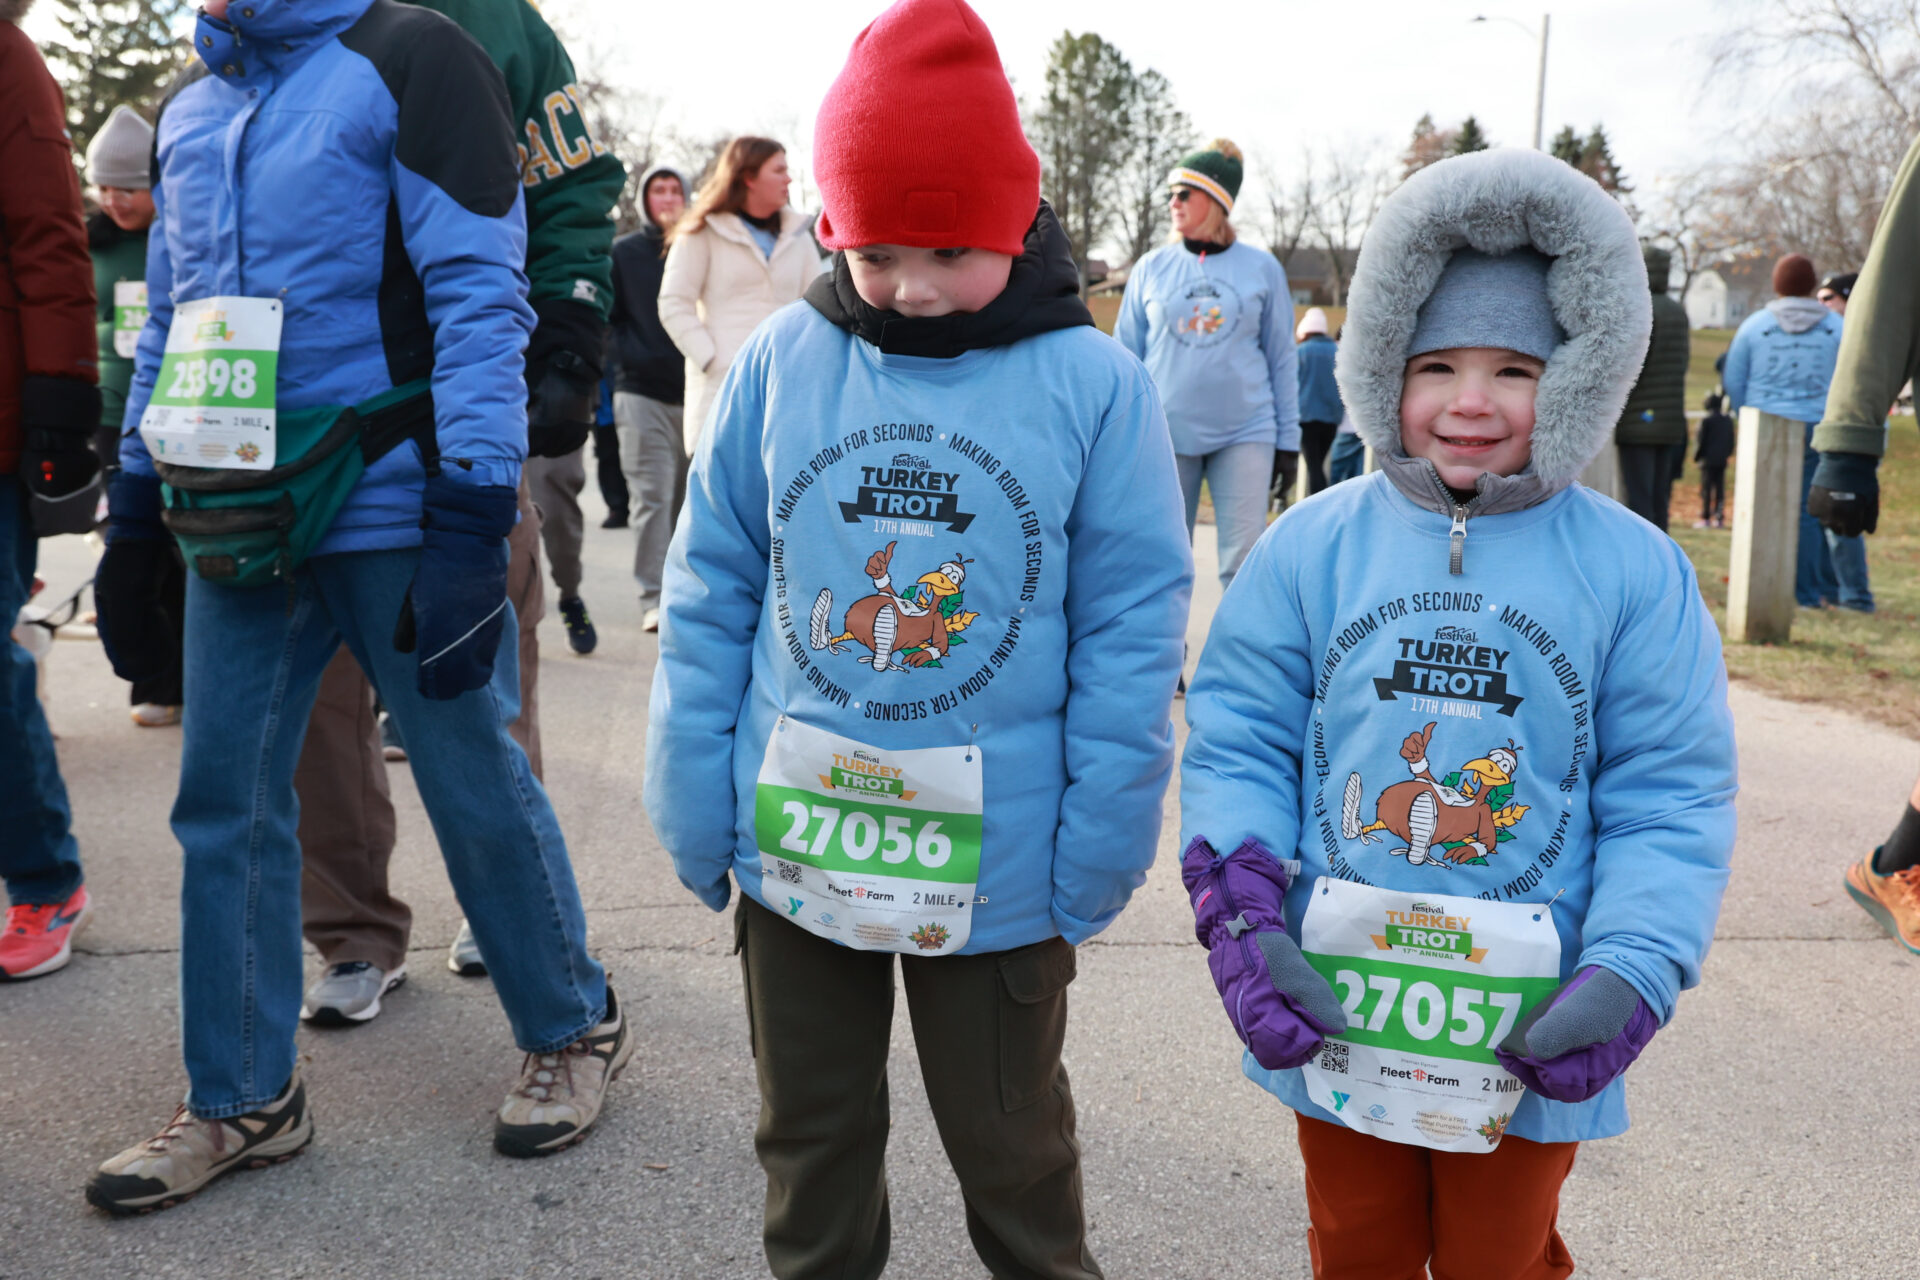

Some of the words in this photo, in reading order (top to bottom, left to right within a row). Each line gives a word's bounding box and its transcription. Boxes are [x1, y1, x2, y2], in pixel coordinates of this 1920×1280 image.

[516, 83, 607, 187] AC
[892, 454, 930, 470] festival
[949, 433, 1001, 475] MAKING
[776, 469, 814, 522] MAKING
[809, 444, 844, 476] ROOM
[843, 429, 869, 453] FOR
[873, 423, 934, 443] SECONDS
[861, 466, 960, 492] TURKEY
[871, 492, 943, 517] TROT
[995, 469, 1030, 511] ROOM
[873, 520, 897, 534] 17TH
[900, 522, 935, 537] ANNUAL
[1019, 510, 1041, 539] FOR
[1020, 541, 1042, 602] SECONDS
[778, 600, 793, 629] FOR
[989, 616, 1022, 668] MAKING
[1316, 647, 1342, 704] MAKING
[1336, 612, 1378, 653] ROOM
[1378, 597, 1408, 625] FOR
[1412, 591, 1483, 613] SECONDS
[1435, 627, 1476, 643] festival
[785, 630, 811, 671] ROOM
[1398, 638, 1510, 670] TURKEY
[958, 664, 995, 700] ROOM
[1410, 666, 1492, 697] TROT
[1499, 605, 1557, 656] MAKING
[1549, 652, 1585, 700] ROOM
[1571, 699, 1588, 731] FOR
[806, 666, 852, 709] MAKING
[930, 690, 958, 714] FOR
[864, 700, 927, 721] SECONDS
[1411, 697, 1439, 715] 17TH
[1441, 702, 1483, 720] ANNUAL
[832, 753, 903, 778] TURKEY
[840, 771, 893, 792] TROT
[780, 800, 952, 868] 27056
[1538, 810, 1572, 868] MAKING
[828, 883, 853, 898] Fleet
[866, 890, 894, 901] Farm
[1503, 862, 1544, 899] ROOM
[913, 892, 920, 904] 2
[924, 893, 956, 906] MILE
[1412, 903, 1444, 915] festival
[1385, 910, 1471, 931] TURKEY
[1397, 928, 1460, 950] TROT
[1419, 950, 1455, 960] ANNUAL
[1336, 969, 1522, 1050] 27057
[1380, 1066, 1412, 1080] Fleet
[1427, 1074, 1460, 1087] Farm
[1482, 1077, 1490, 1091] 2
